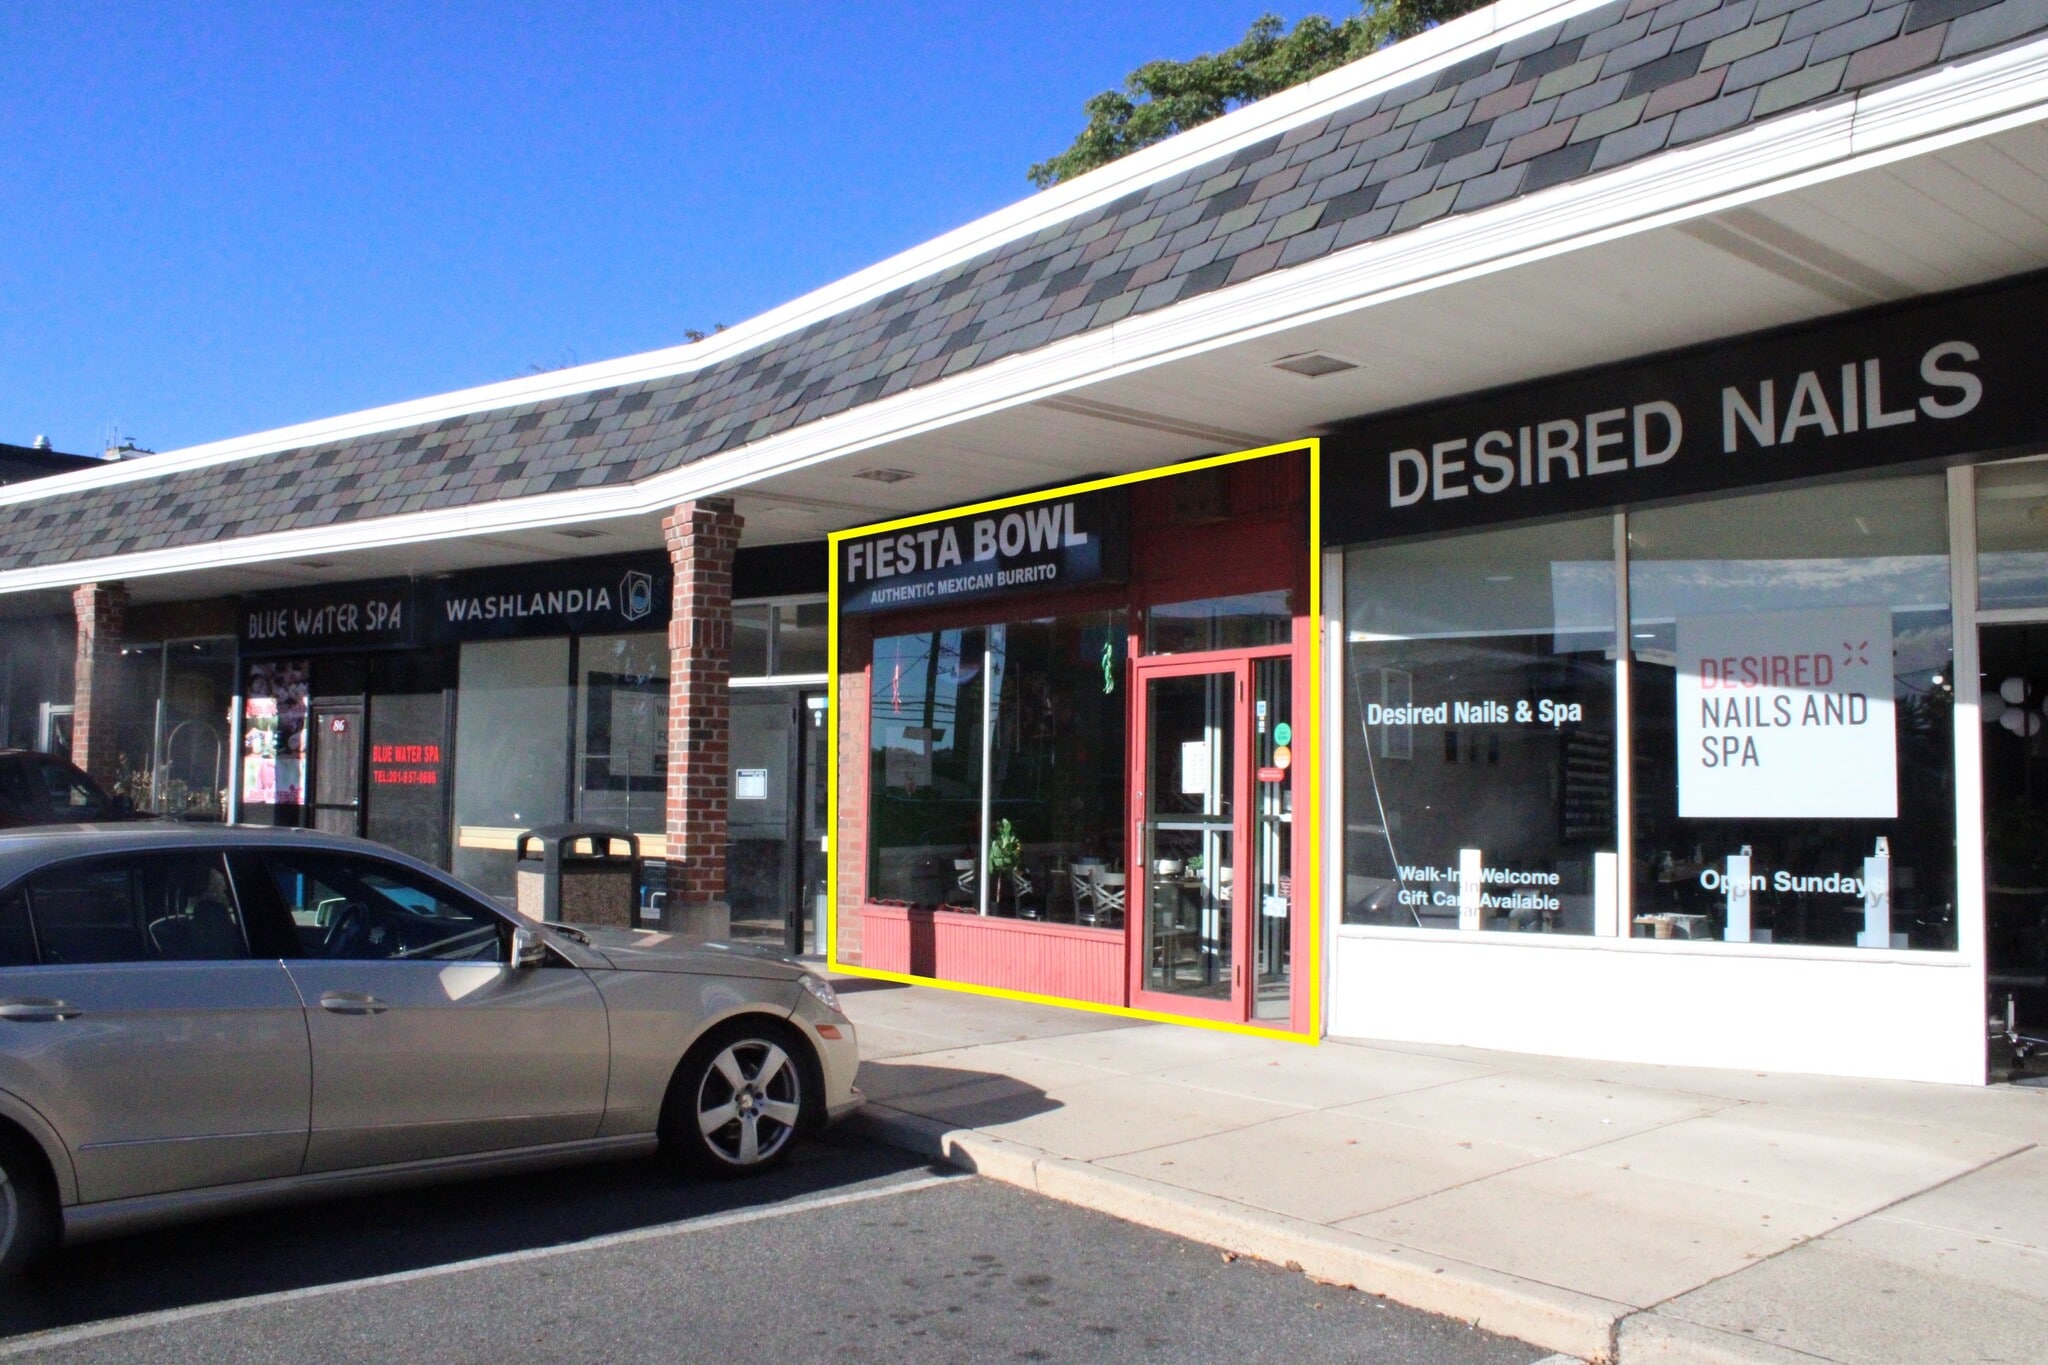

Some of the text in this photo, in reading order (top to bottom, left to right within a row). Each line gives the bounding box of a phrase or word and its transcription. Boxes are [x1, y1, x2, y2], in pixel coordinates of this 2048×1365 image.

[1388, 340, 1984, 508] DESIRED NAILS
[847, 502, 1088, 582] FIESTA BOWL
[870, 563, 1057, 604] AUTHENTIC MEXICAN BURRITO
[248, 599, 402, 640] BLUE WATER SPA
[445, 587, 612, 623] WASHLANDIA
[1700, 653, 1834, 690] DESIRED
[332, 719, 346, 732] 86
[1367, 698, 1583, 728] Desired Nails & Spa
[1701, 692, 1868, 729] NAILS AND
[373, 745, 440, 763] BLUE WATER SPA
[1701, 735, 1760, 768] SPA
[1479, 867, 1560, 885] Welcome
[1397, 889, 1560, 910] Gift Car Available
